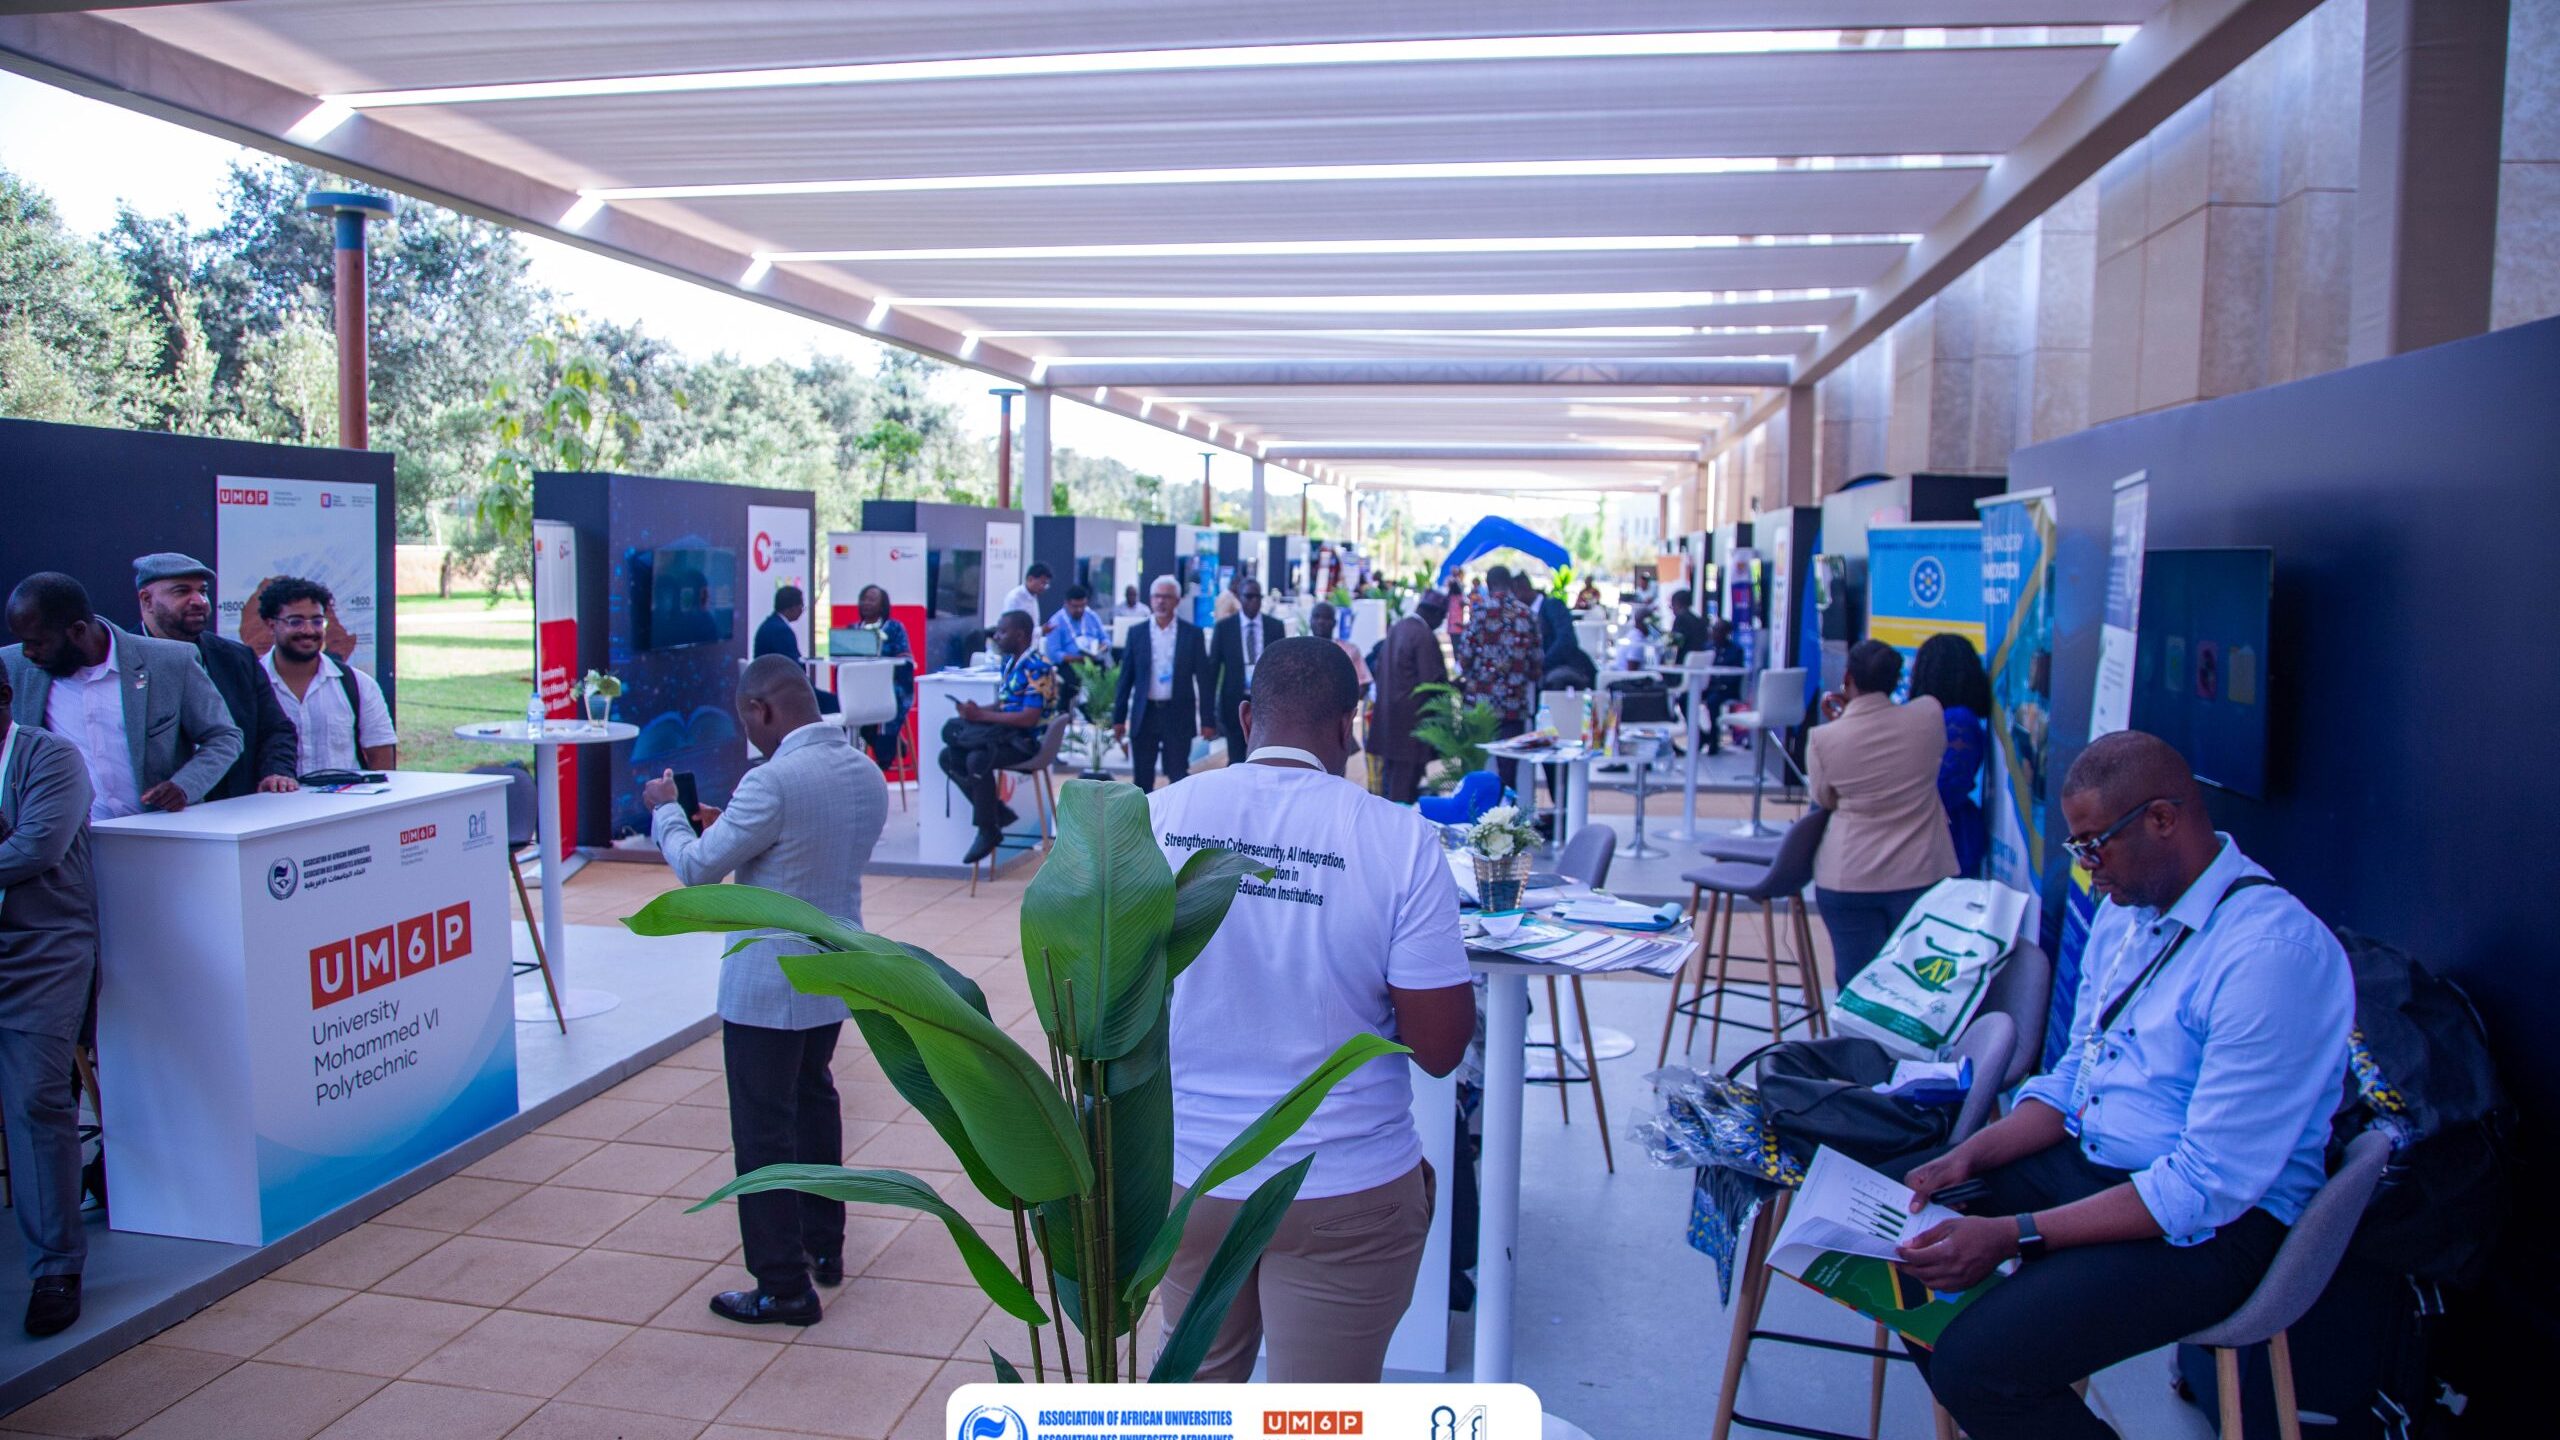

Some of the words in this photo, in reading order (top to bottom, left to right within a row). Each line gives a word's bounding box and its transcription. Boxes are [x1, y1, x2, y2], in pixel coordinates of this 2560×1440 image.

[220, 490, 268, 504] UM6P
[401, 825, 436, 844] UM6P
[1164, 832, 1226, 851] Strengthening
[1226, 837, 1286, 863] Cybersecurity,
[1287, 846, 1297, 861] AI
[1297, 847, 1346, 871] Integration,
[1238, 879, 1277, 899] Education
[1277, 885, 1324, 906] Institutions
[1291, 866, 1299, 881] in
[315, 907, 467, 1002] UM6P
[312, 1000, 400, 1046] University
[314, 1014, 420, 1076] Mohammed
[423, 1007, 439, 1030] VI
[316, 1049, 418, 1106] Polytechnic
